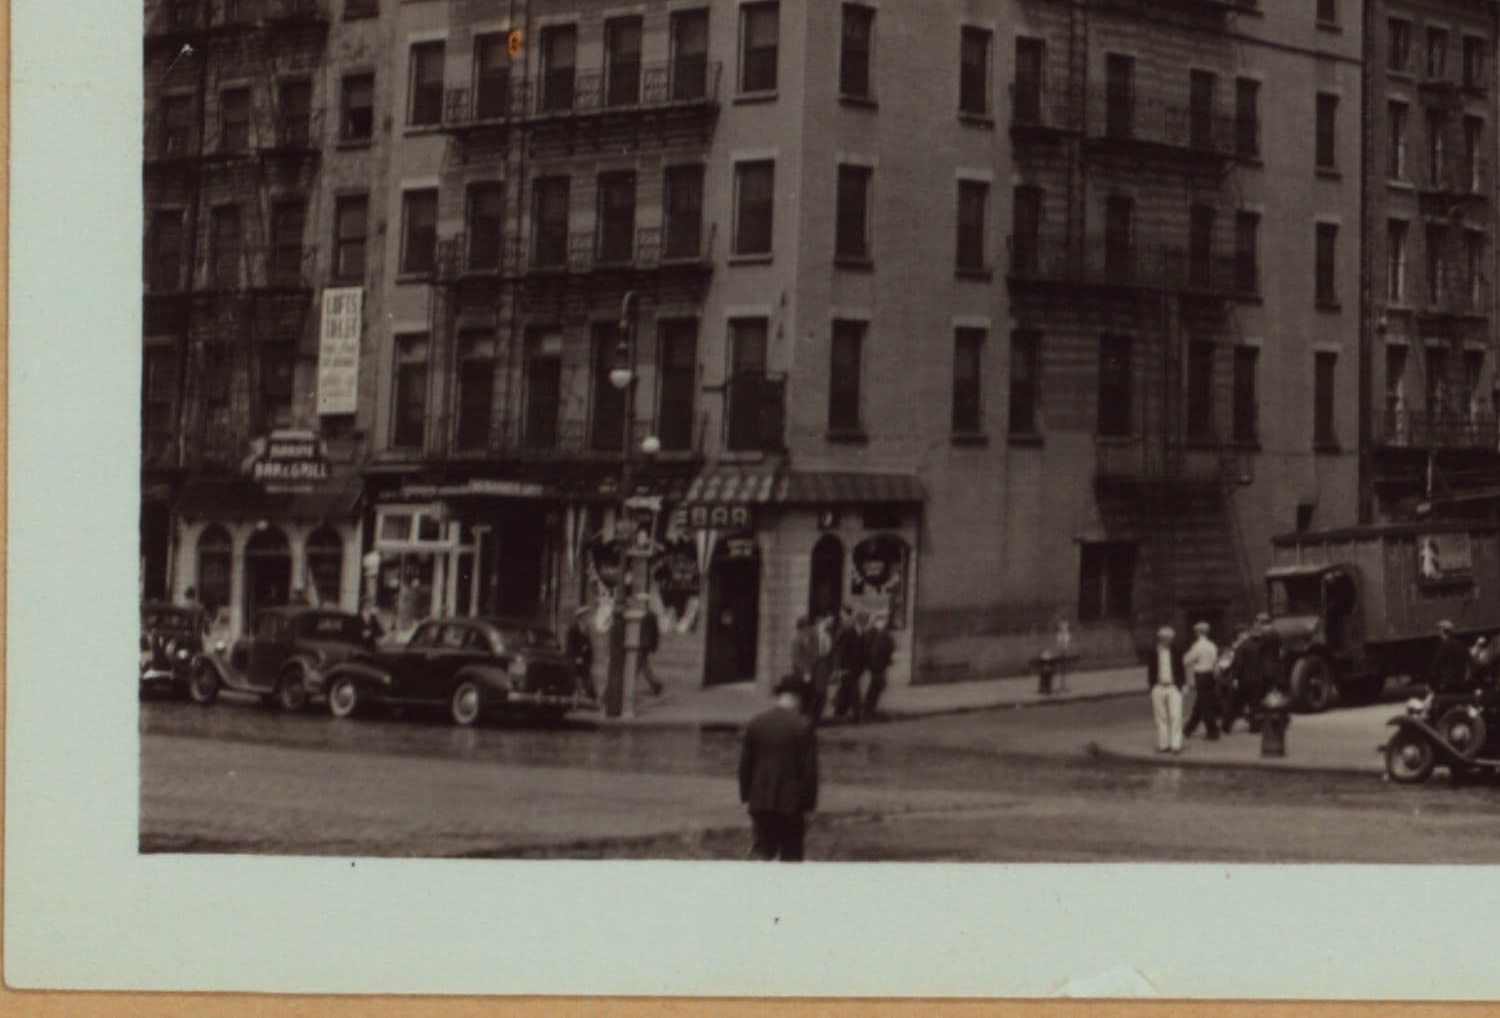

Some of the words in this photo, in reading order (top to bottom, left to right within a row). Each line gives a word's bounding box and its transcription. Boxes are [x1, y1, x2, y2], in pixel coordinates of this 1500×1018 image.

[254, 462, 281, 479] BAR
[290, 462, 327, 478] GRILL
[691, 506, 748, 528] BAR
